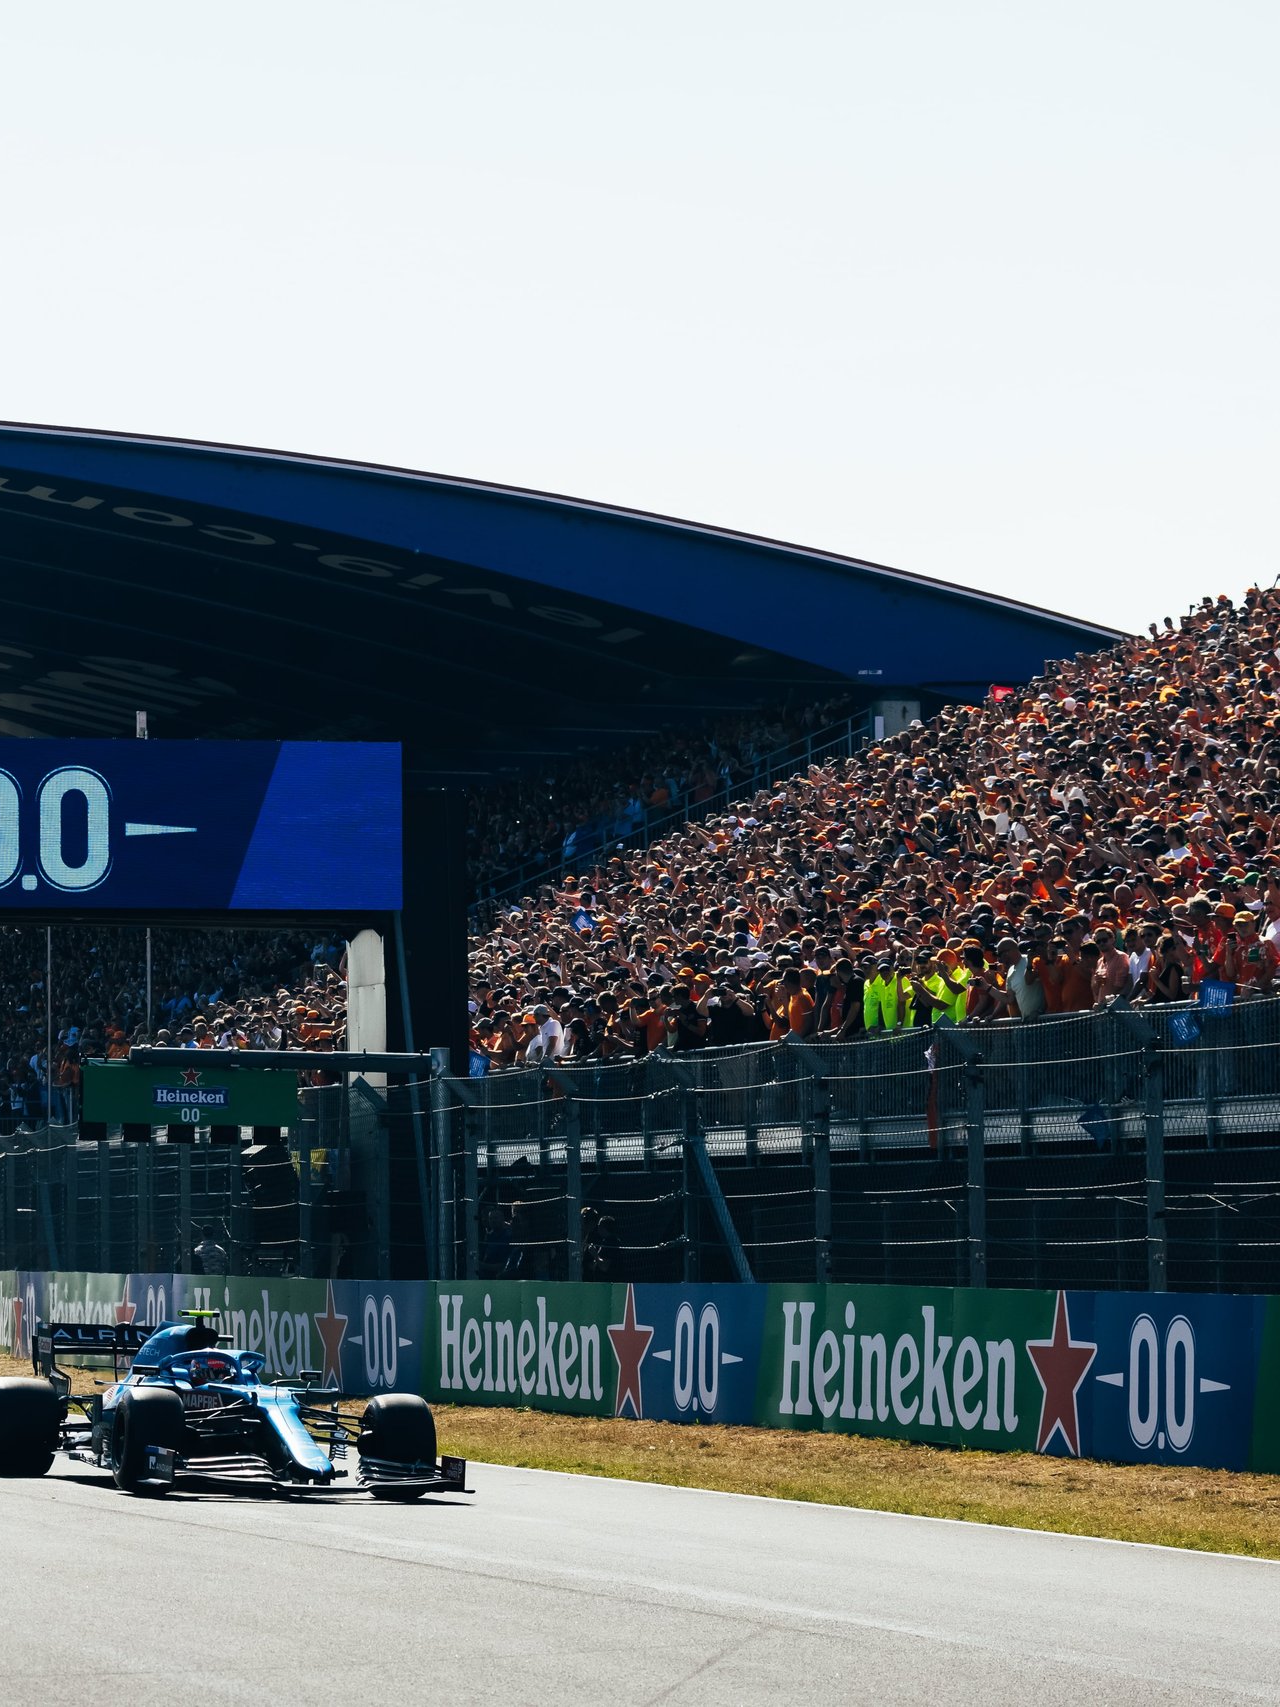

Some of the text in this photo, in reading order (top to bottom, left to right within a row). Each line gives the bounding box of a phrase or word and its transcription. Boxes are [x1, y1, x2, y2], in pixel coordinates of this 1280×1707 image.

[156, 1088, 225, 1104] Heineken
[53, 1328, 155, 1341] ALPIN
[362, 1294, 398, 1391] 0.0
[437, 1294, 721, 1414] Heineken 0.0
[182, 1393, 219, 1409] MAPFRE
[778, 1299, 1195, 1454] Heineken 0.0
